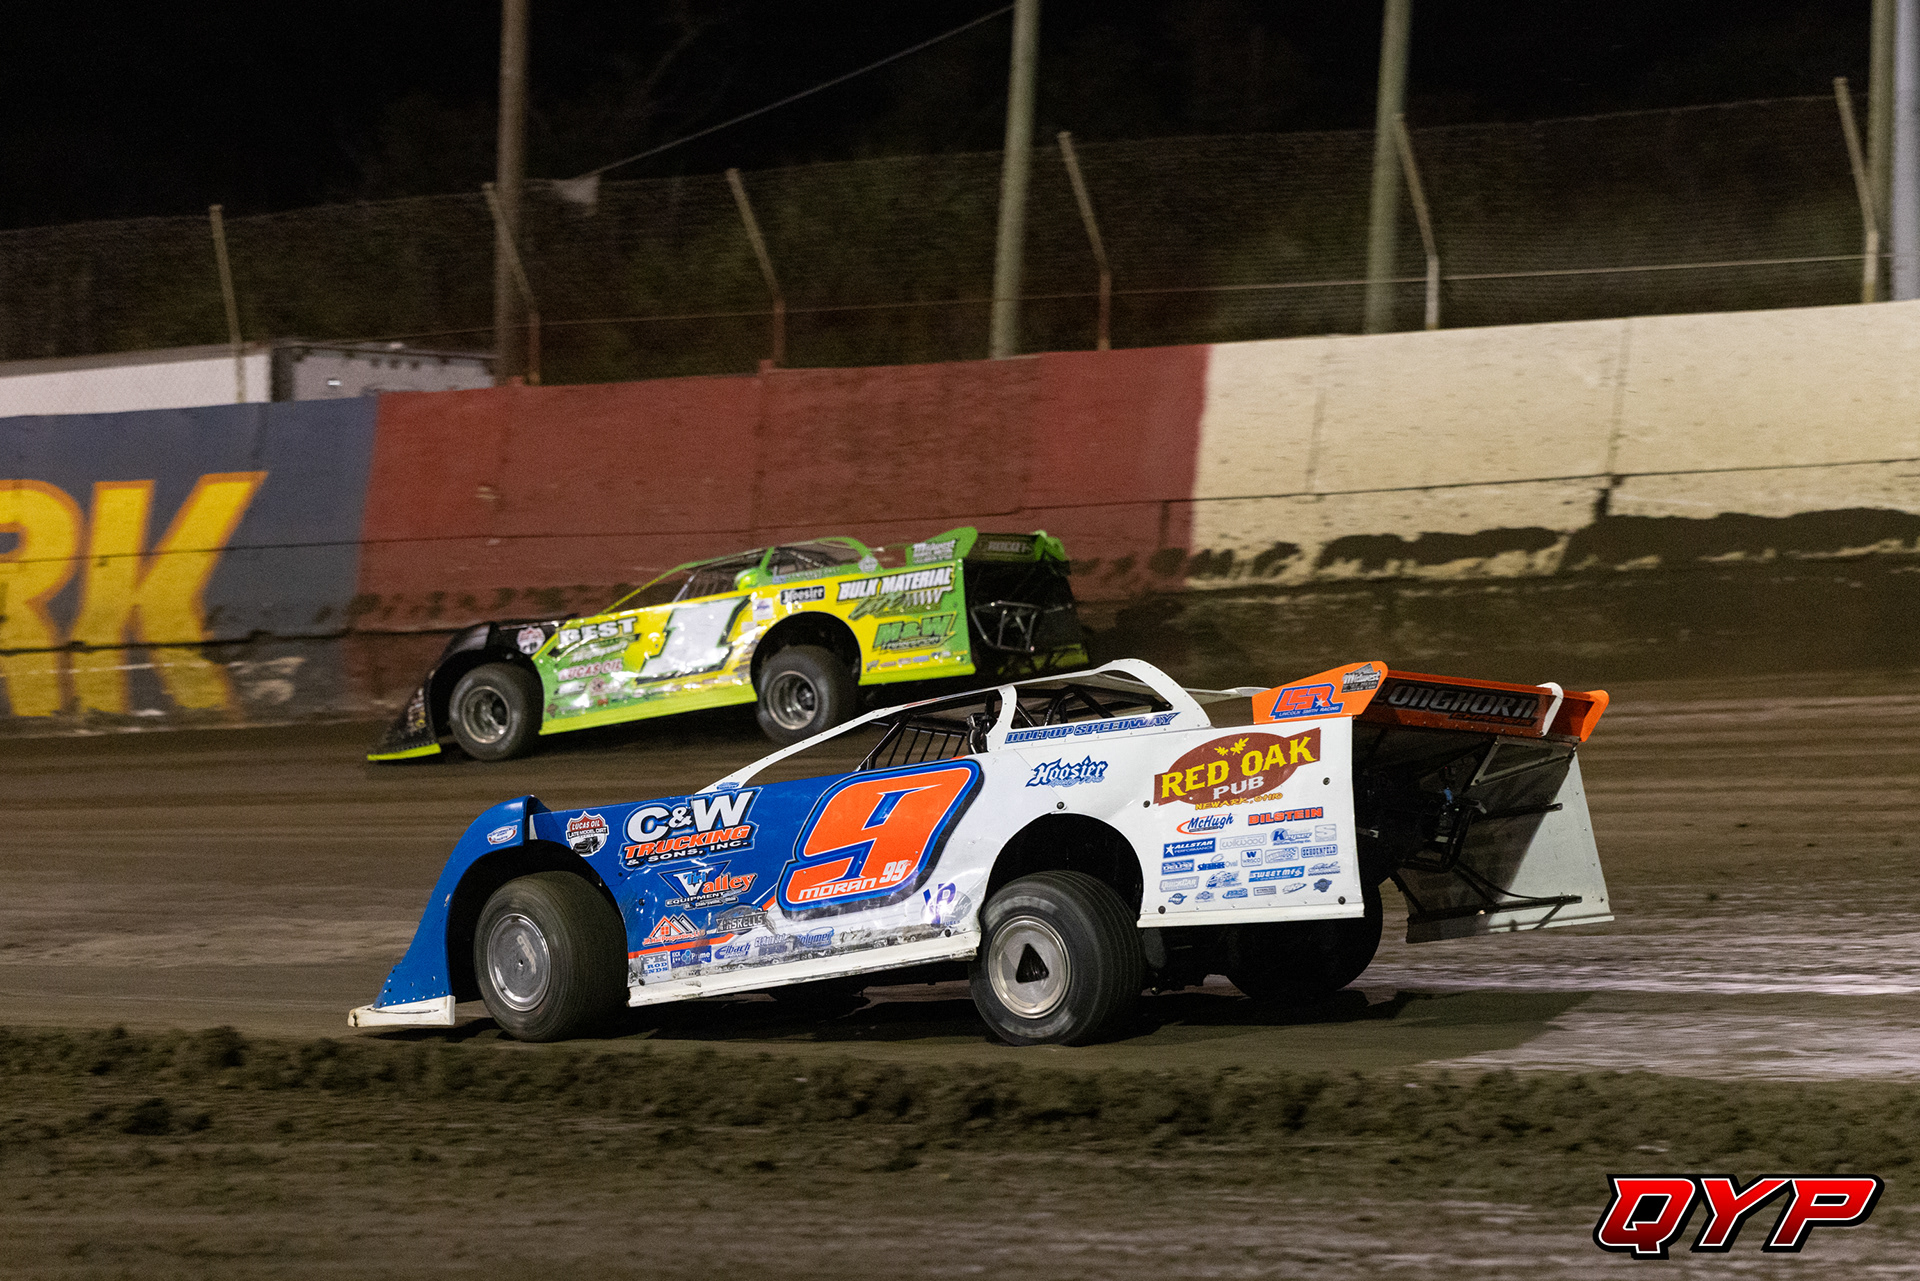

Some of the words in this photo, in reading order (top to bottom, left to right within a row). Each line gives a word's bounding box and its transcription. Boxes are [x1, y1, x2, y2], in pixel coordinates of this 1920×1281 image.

[837, 577, 879, 602] BULK
[880, 566, 953, 595] MATERIAL
[559, 617, 638, 650] BEST
[636, 595, 748, 682] 1
[873, 614, 952, 649] M&W
[601, 658, 623, 674] OIL
[1275, 685, 1332, 713] LSR
[1279, 709, 1301, 717] LINCOLN
[1320, 705, 1340, 713] RACING
[1005, 725, 1073, 744] HILLTOP
[1075, 712, 1180, 735] SPEEDWAY
[1025, 755, 1109, 788] Hoosier
[1161, 759, 1229, 799] RED
[1241, 736, 1316, 777] OAK
[1213, 776, 1265, 800] PUB
[1254, 792, 1284, 803] OHIO
[571, 821, 591, 831] LUCAS
[590, 819, 601, 828] OIL
[627, 790, 755, 843] C&W
[1187, 813, 1234, 830] McHugh
[1248, 807, 1324, 826] BILSTEIN
[568, 831, 580, 839] LATE
[595, 827, 608, 835] DIRT
[625, 825, 751, 859] TRUCKING
[785, 767, 972, 903] 9
[1174, 840, 1213, 850] ALLSTAR
[1221, 834, 1265, 848] wilwood
[1272, 830, 1312, 841] Keyser
[627, 857, 640, 866] &
[648, 848, 704, 863] SONS,
[710, 840, 748, 852] INC.
[1174, 845, 1213, 854] PERFORMANCE
[1302, 846, 1337, 857] SCHOENFELD
[673, 867, 755, 897] Valley
[798, 878, 877, 900] MORAN
[879, 860, 908, 885] 99
[1251, 870, 1281, 878] SWEET
[666, 892, 724, 906] EQUIPMENT
